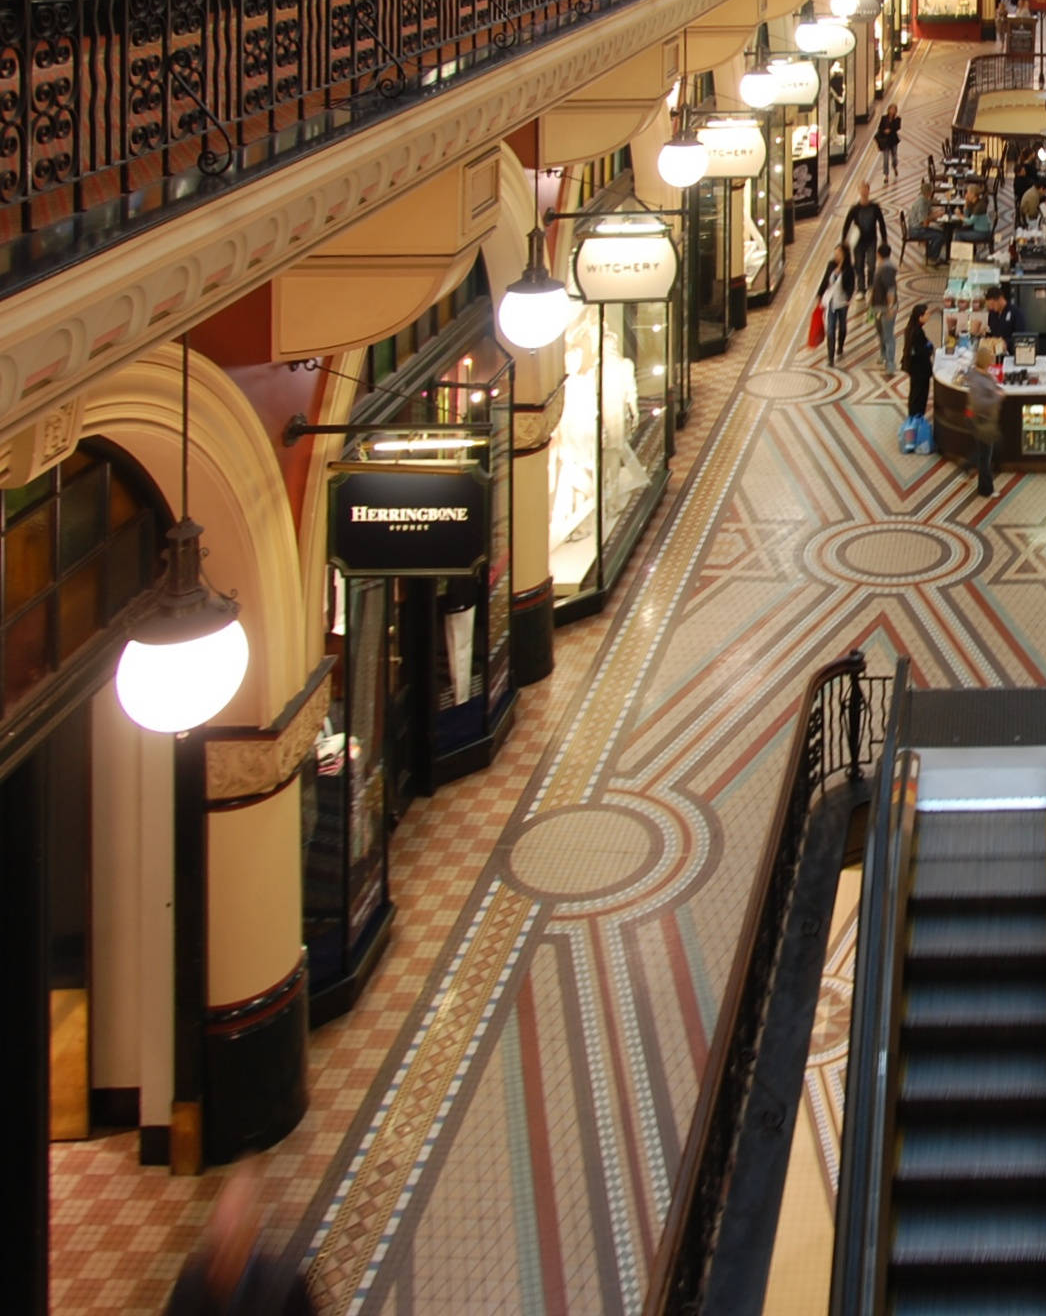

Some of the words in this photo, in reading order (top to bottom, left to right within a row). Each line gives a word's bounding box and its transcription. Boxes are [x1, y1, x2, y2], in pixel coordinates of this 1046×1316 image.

[708, 149, 754, 157] ITCHERY
[586, 262, 660, 273] WITCHERY
[351, 505, 469, 523] HERRINGBONE
[389, 524, 430, 532] SYDNEY
